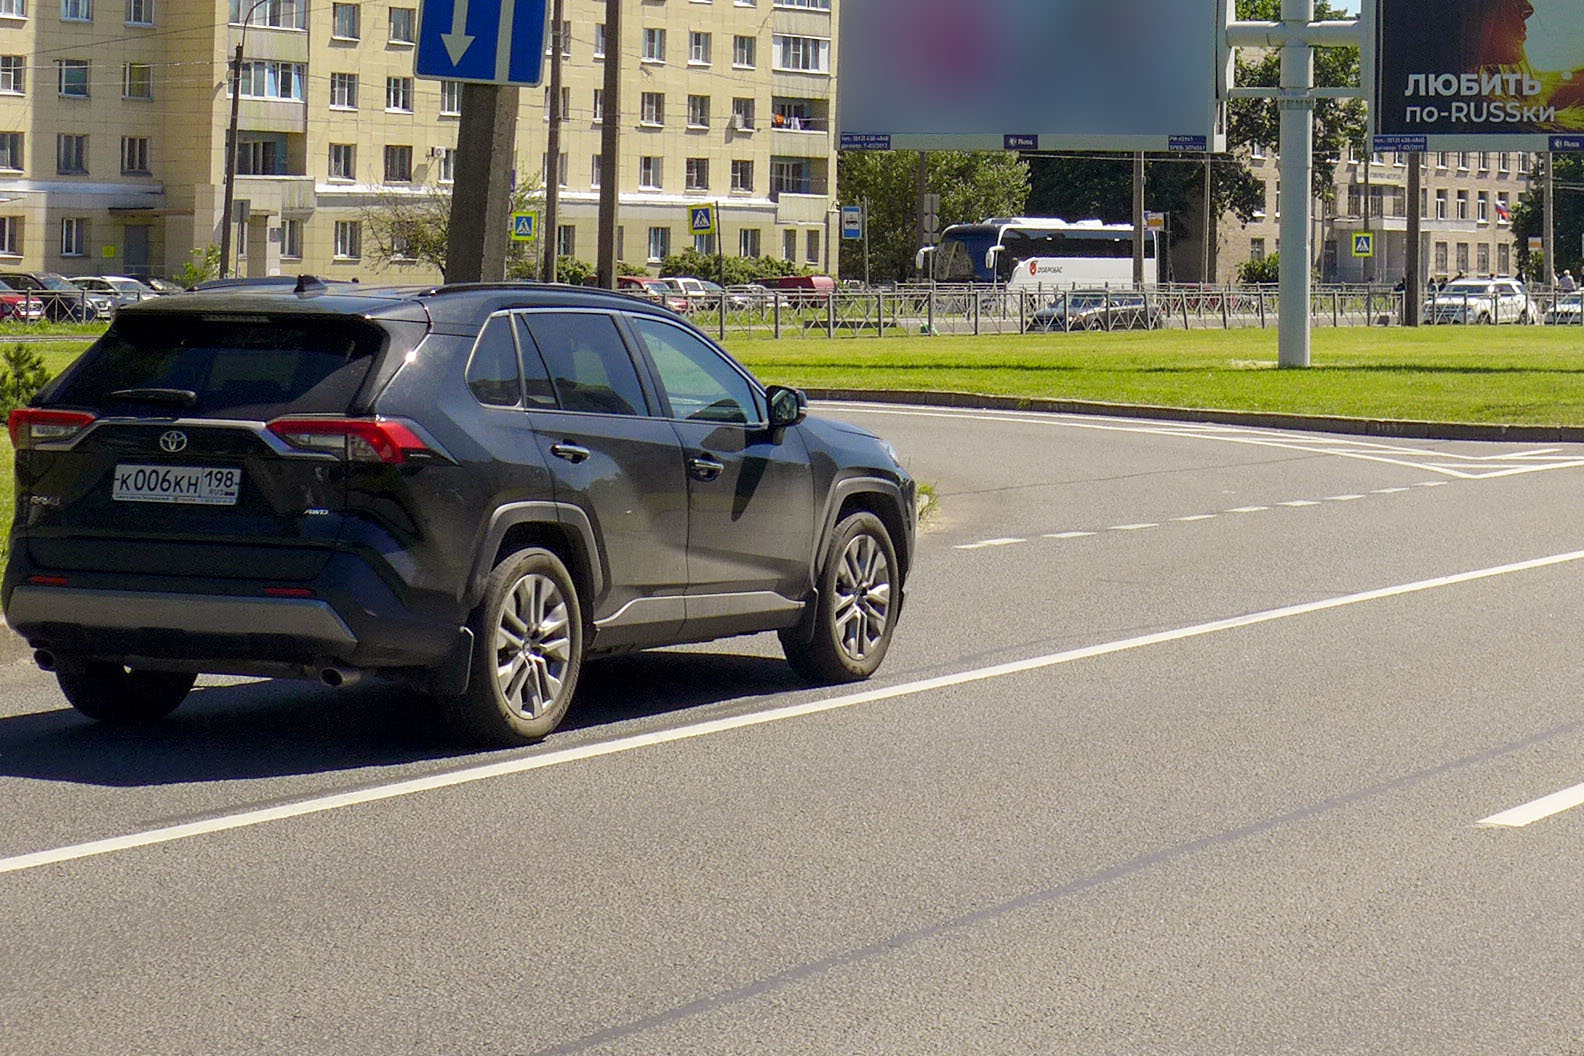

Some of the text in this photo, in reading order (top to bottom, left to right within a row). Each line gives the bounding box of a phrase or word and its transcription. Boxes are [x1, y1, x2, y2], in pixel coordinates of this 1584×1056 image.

[1404, 73, 1542, 96] ЛЮБИТЬ
[1405, 102, 1555, 123] по-RUSSки
[119, 469, 234, 493] К006КН 198
